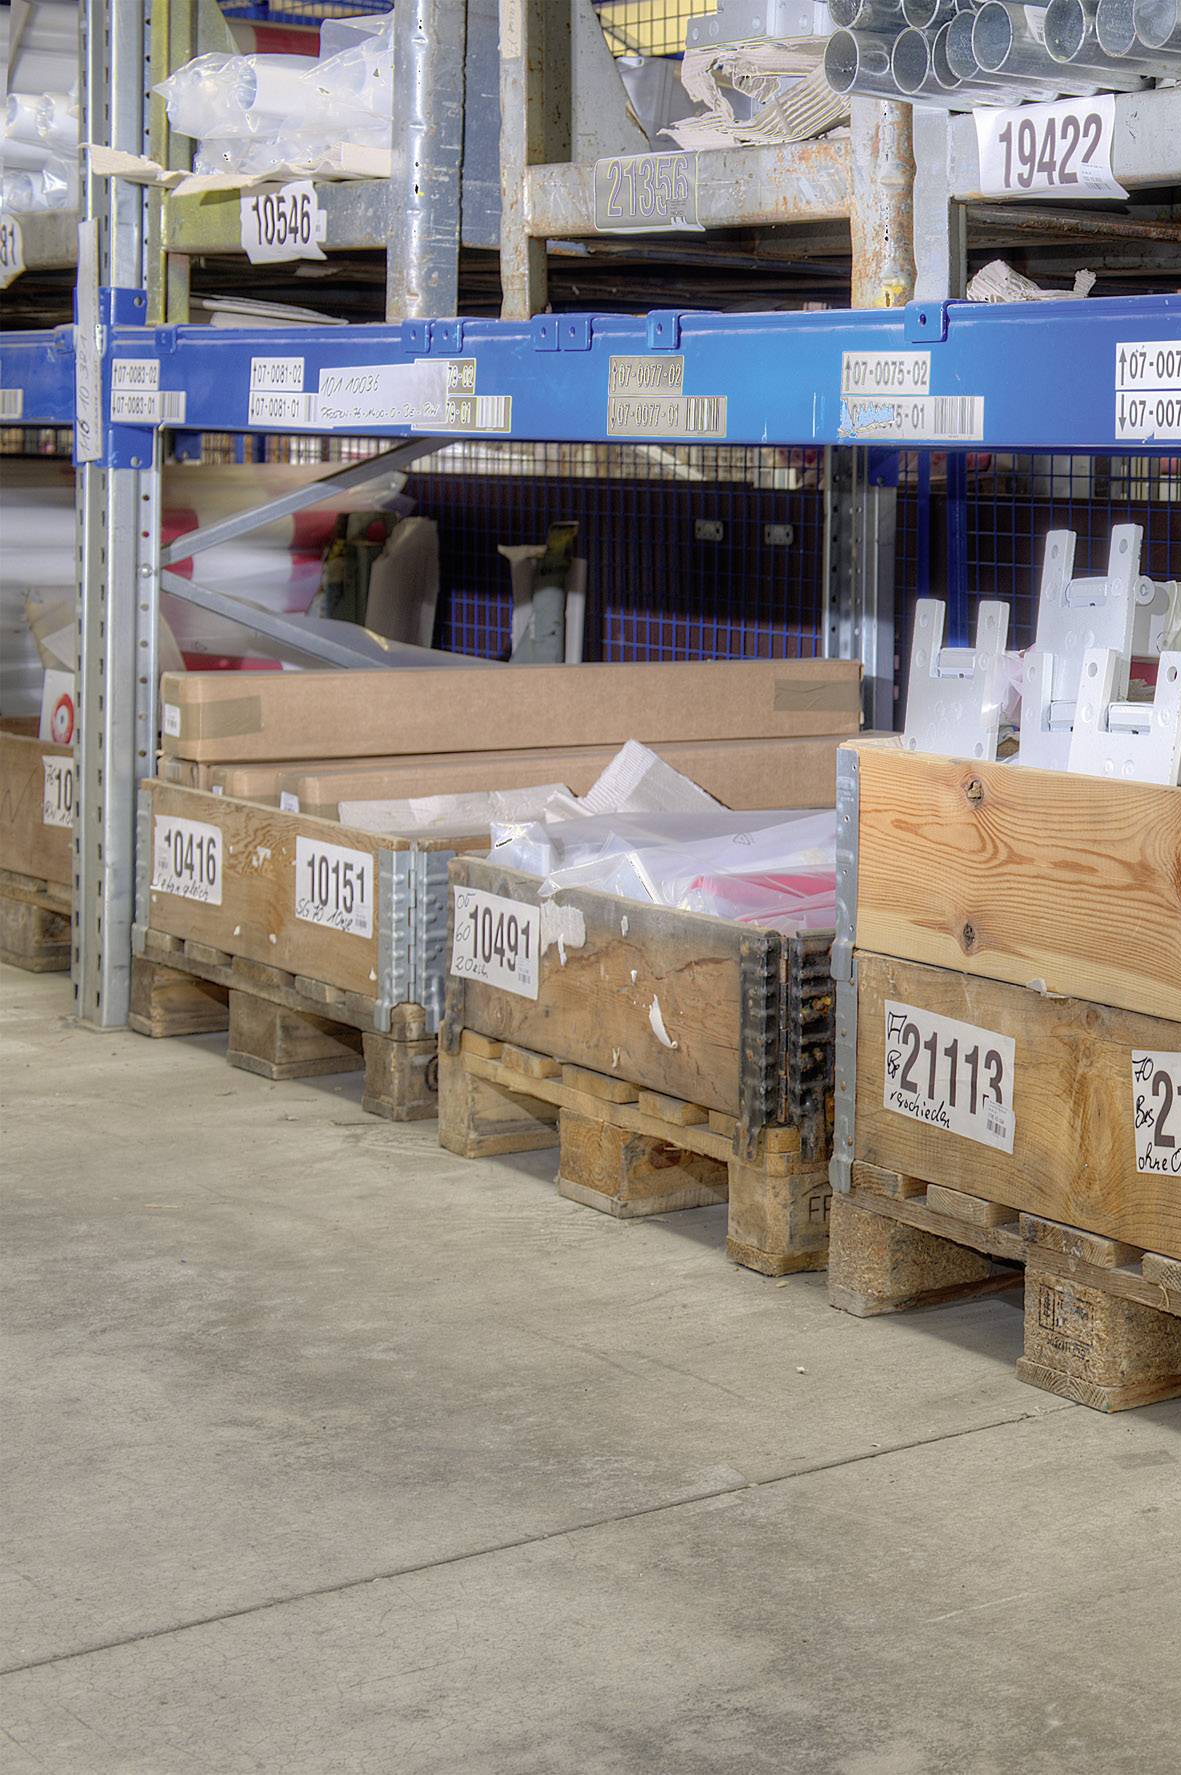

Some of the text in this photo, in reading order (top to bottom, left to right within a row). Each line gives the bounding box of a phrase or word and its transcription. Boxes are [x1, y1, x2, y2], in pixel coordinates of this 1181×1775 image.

[999, 112, 1103, 189] 19422
[607, 155, 689, 217] 21356
[251, 193, 311, 246] 10546
[257, 364, 302, 384] 07-0081-02
[618, 363, 681, 388] 07-0077-02
[853, 360, 928, 386] 07-0075-02
[255, 398, 300, 418] 07-0081-01
[617, 403, 679, 427] 07-0077-01
[164, 828, 217, 886] 10416
[307, 853, 365, 914] 10151
[469, 904, 530, 972] 10491
[900, 1022, 1004, 1115] 21113
